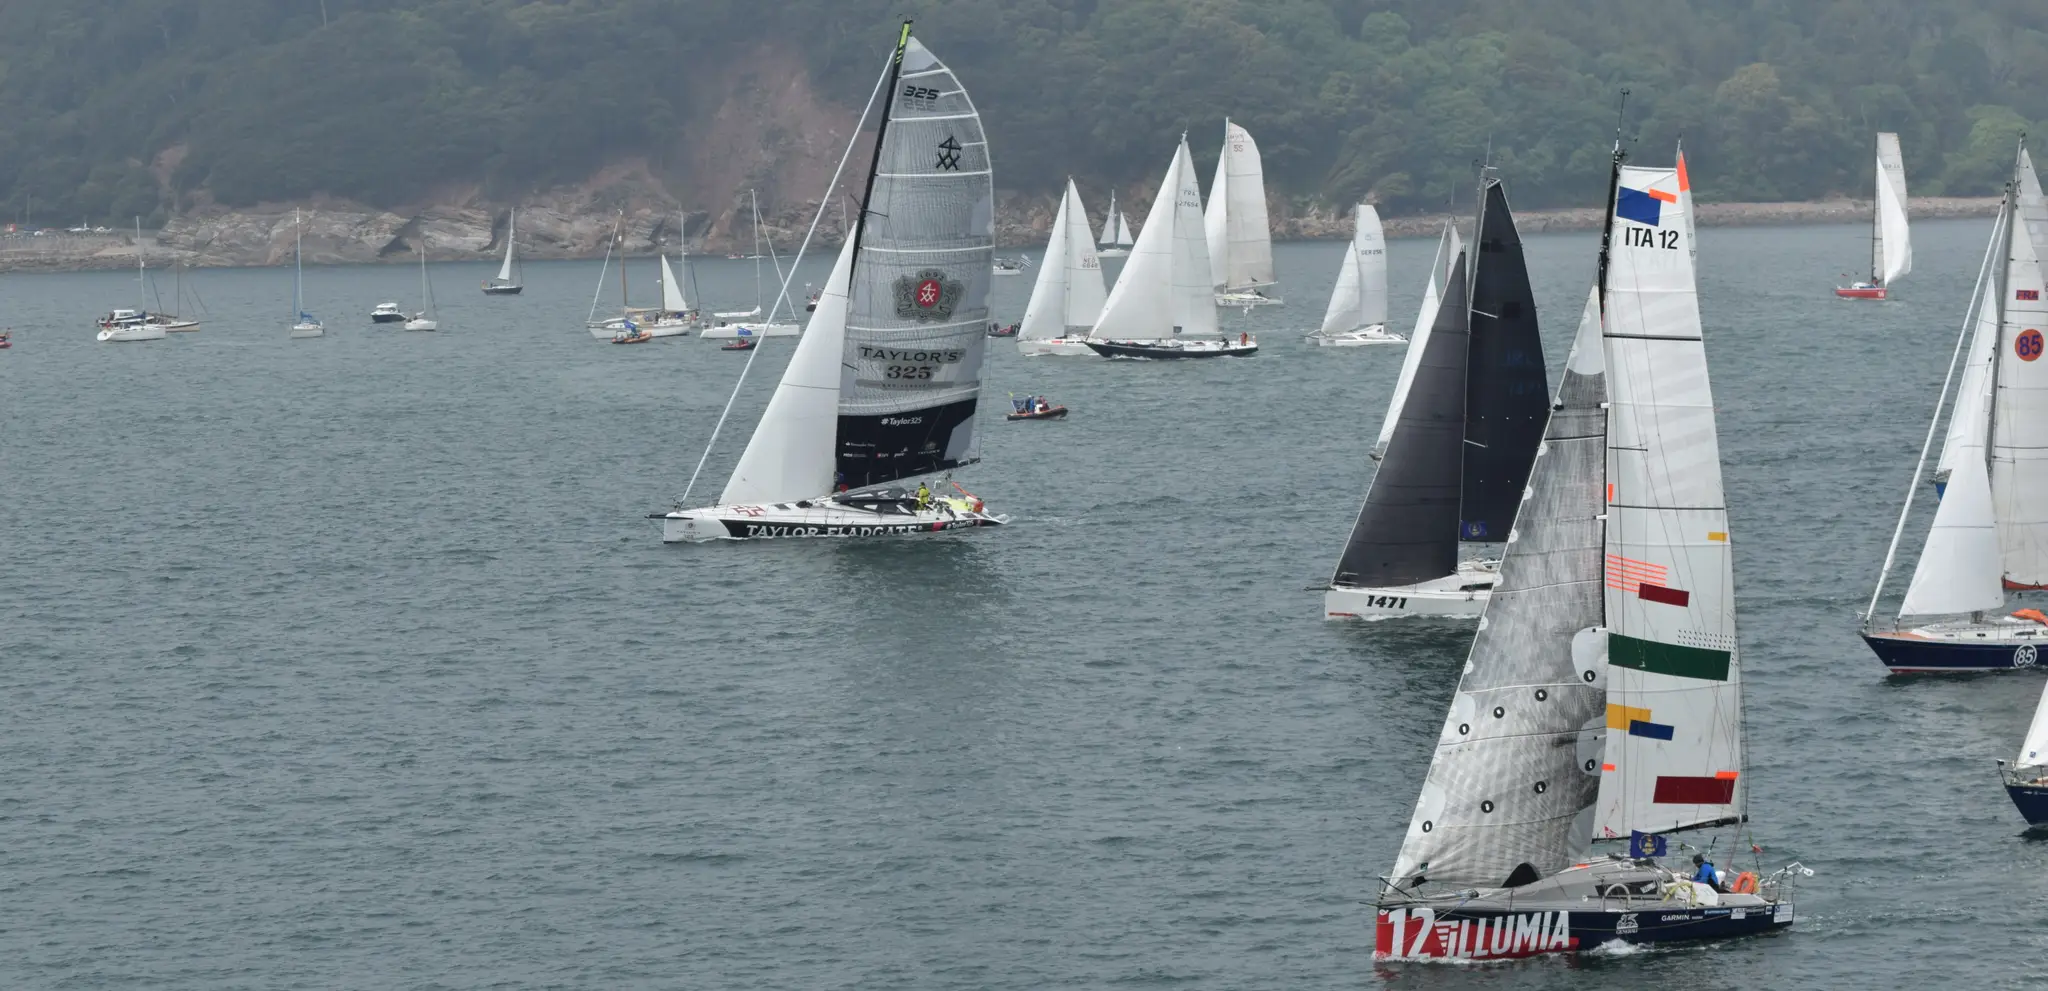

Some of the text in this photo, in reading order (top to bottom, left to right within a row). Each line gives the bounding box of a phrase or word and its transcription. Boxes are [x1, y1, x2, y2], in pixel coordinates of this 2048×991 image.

[904, 86, 939, 100] 325
[1625, 226, 1679, 250] ITA 12
[2016, 290, 2039, 300] FRA
[2019, 334, 2042, 356] 85
[860, 346, 959, 363] TAYLOR'S
[886, 365, 933, 380] 325
[880, 416, 923, 427] #Taylor325
[746, 524, 819, 538] TAYLOR
[1366, 594, 1408, 609] 1471
[2016, 649, 2034, 665] 85
[1661, 914, 1690, 922] GARMIN
[1388, 907, 1436, 959] 12
